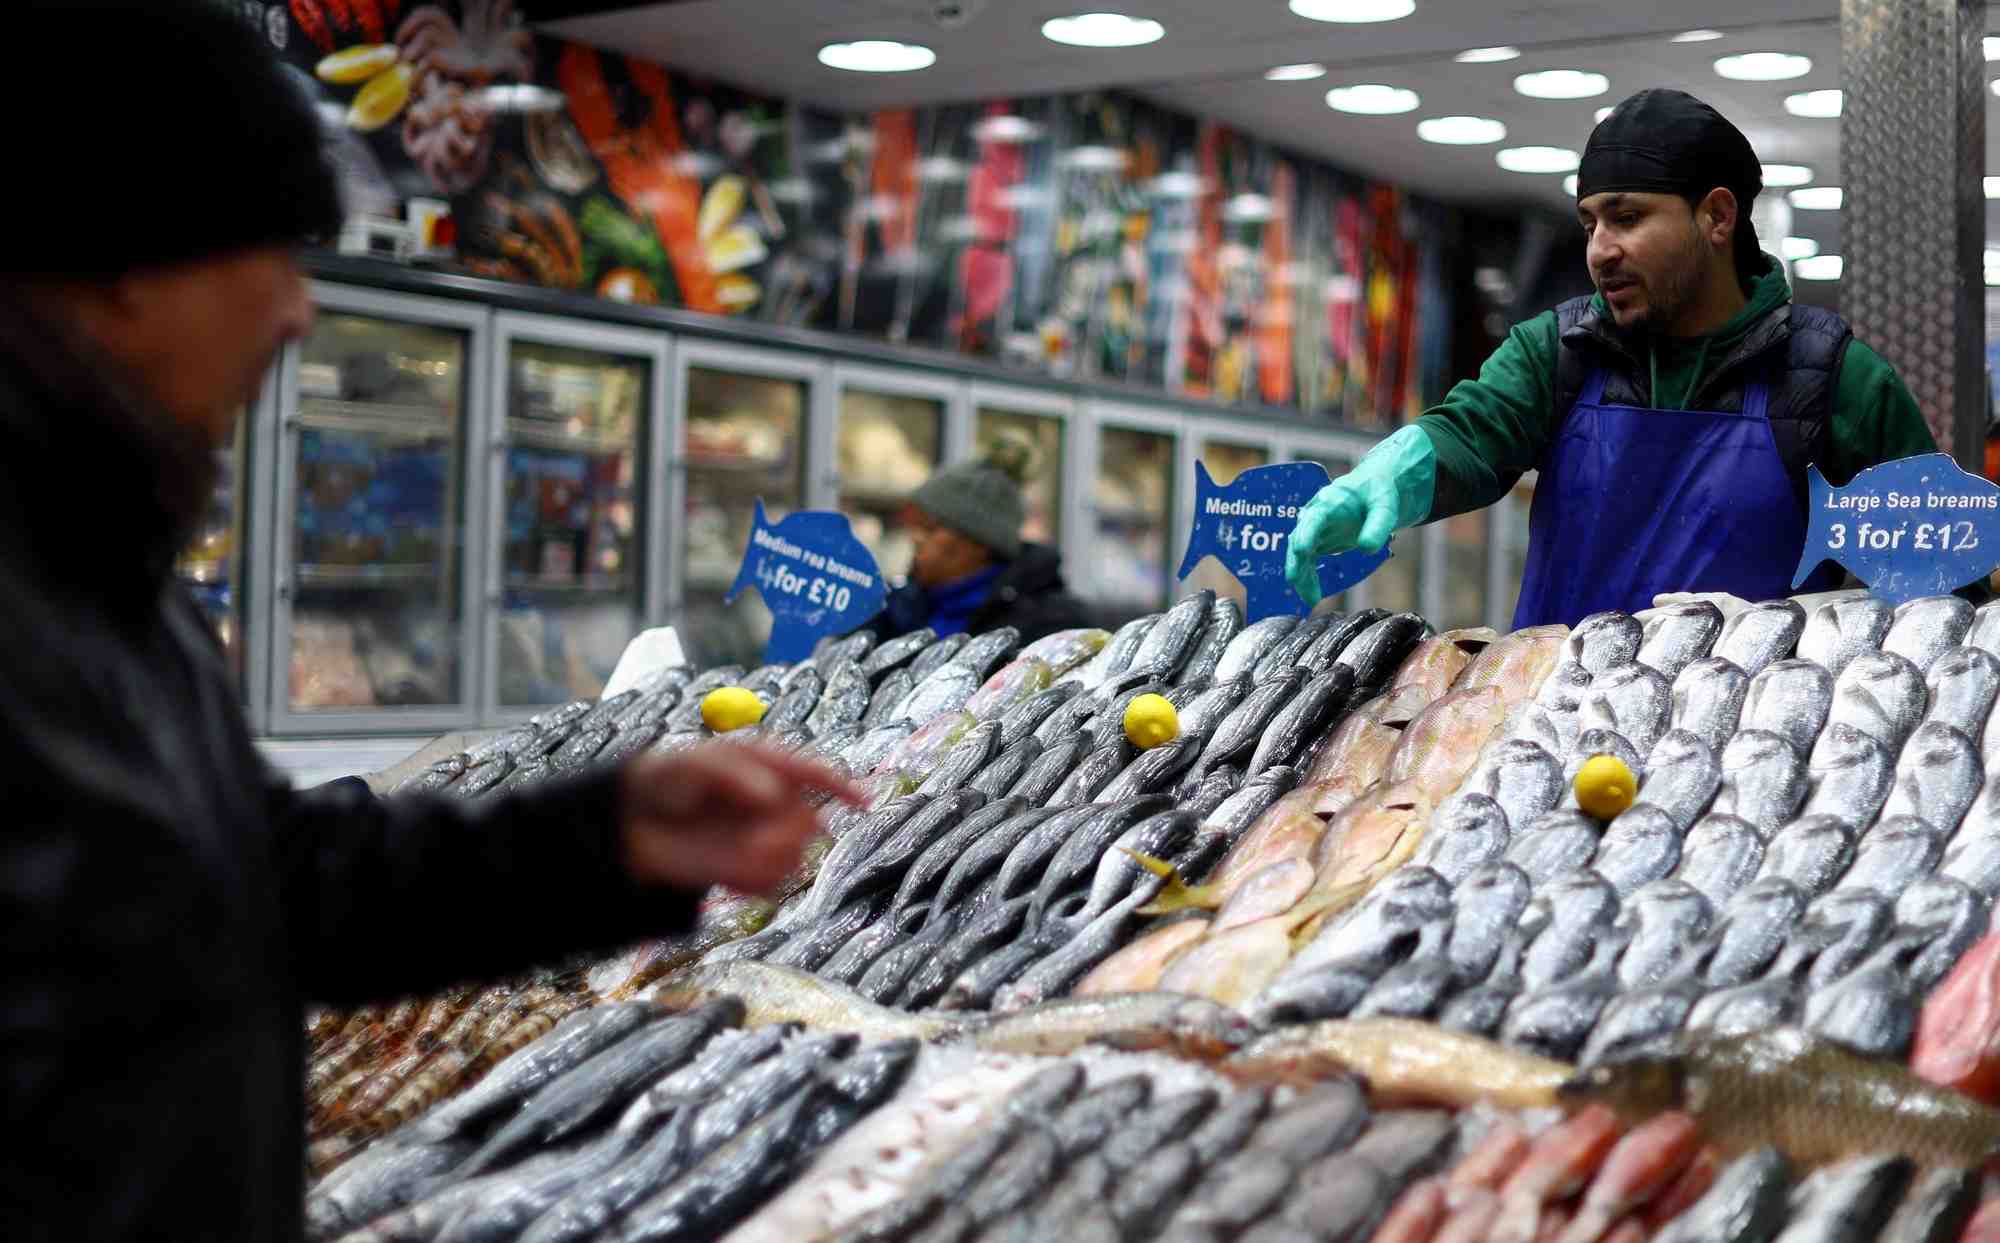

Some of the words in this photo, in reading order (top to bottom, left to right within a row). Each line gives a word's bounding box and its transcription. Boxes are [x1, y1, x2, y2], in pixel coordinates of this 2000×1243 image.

[1205, 497, 1272, 517] Medium
[1277, 504, 1302, 519] se
[1827, 492, 1880, 513] Large
[1887, 491, 1921, 509] Sea
[1927, 491, 1998, 509] breams
[1240, 524, 1284, 552] for
[1827, 523, 1847, 550] 3
[1857, 522, 1906, 549] for
[1914, 521, 1979, 552] £12
[754, 528, 802, 560] Medium
[826, 557, 873, 588] breams
[1236, 559, 1256, 577] 2
[773, 564, 808, 596] for
[808, 578, 850, 612] £10
